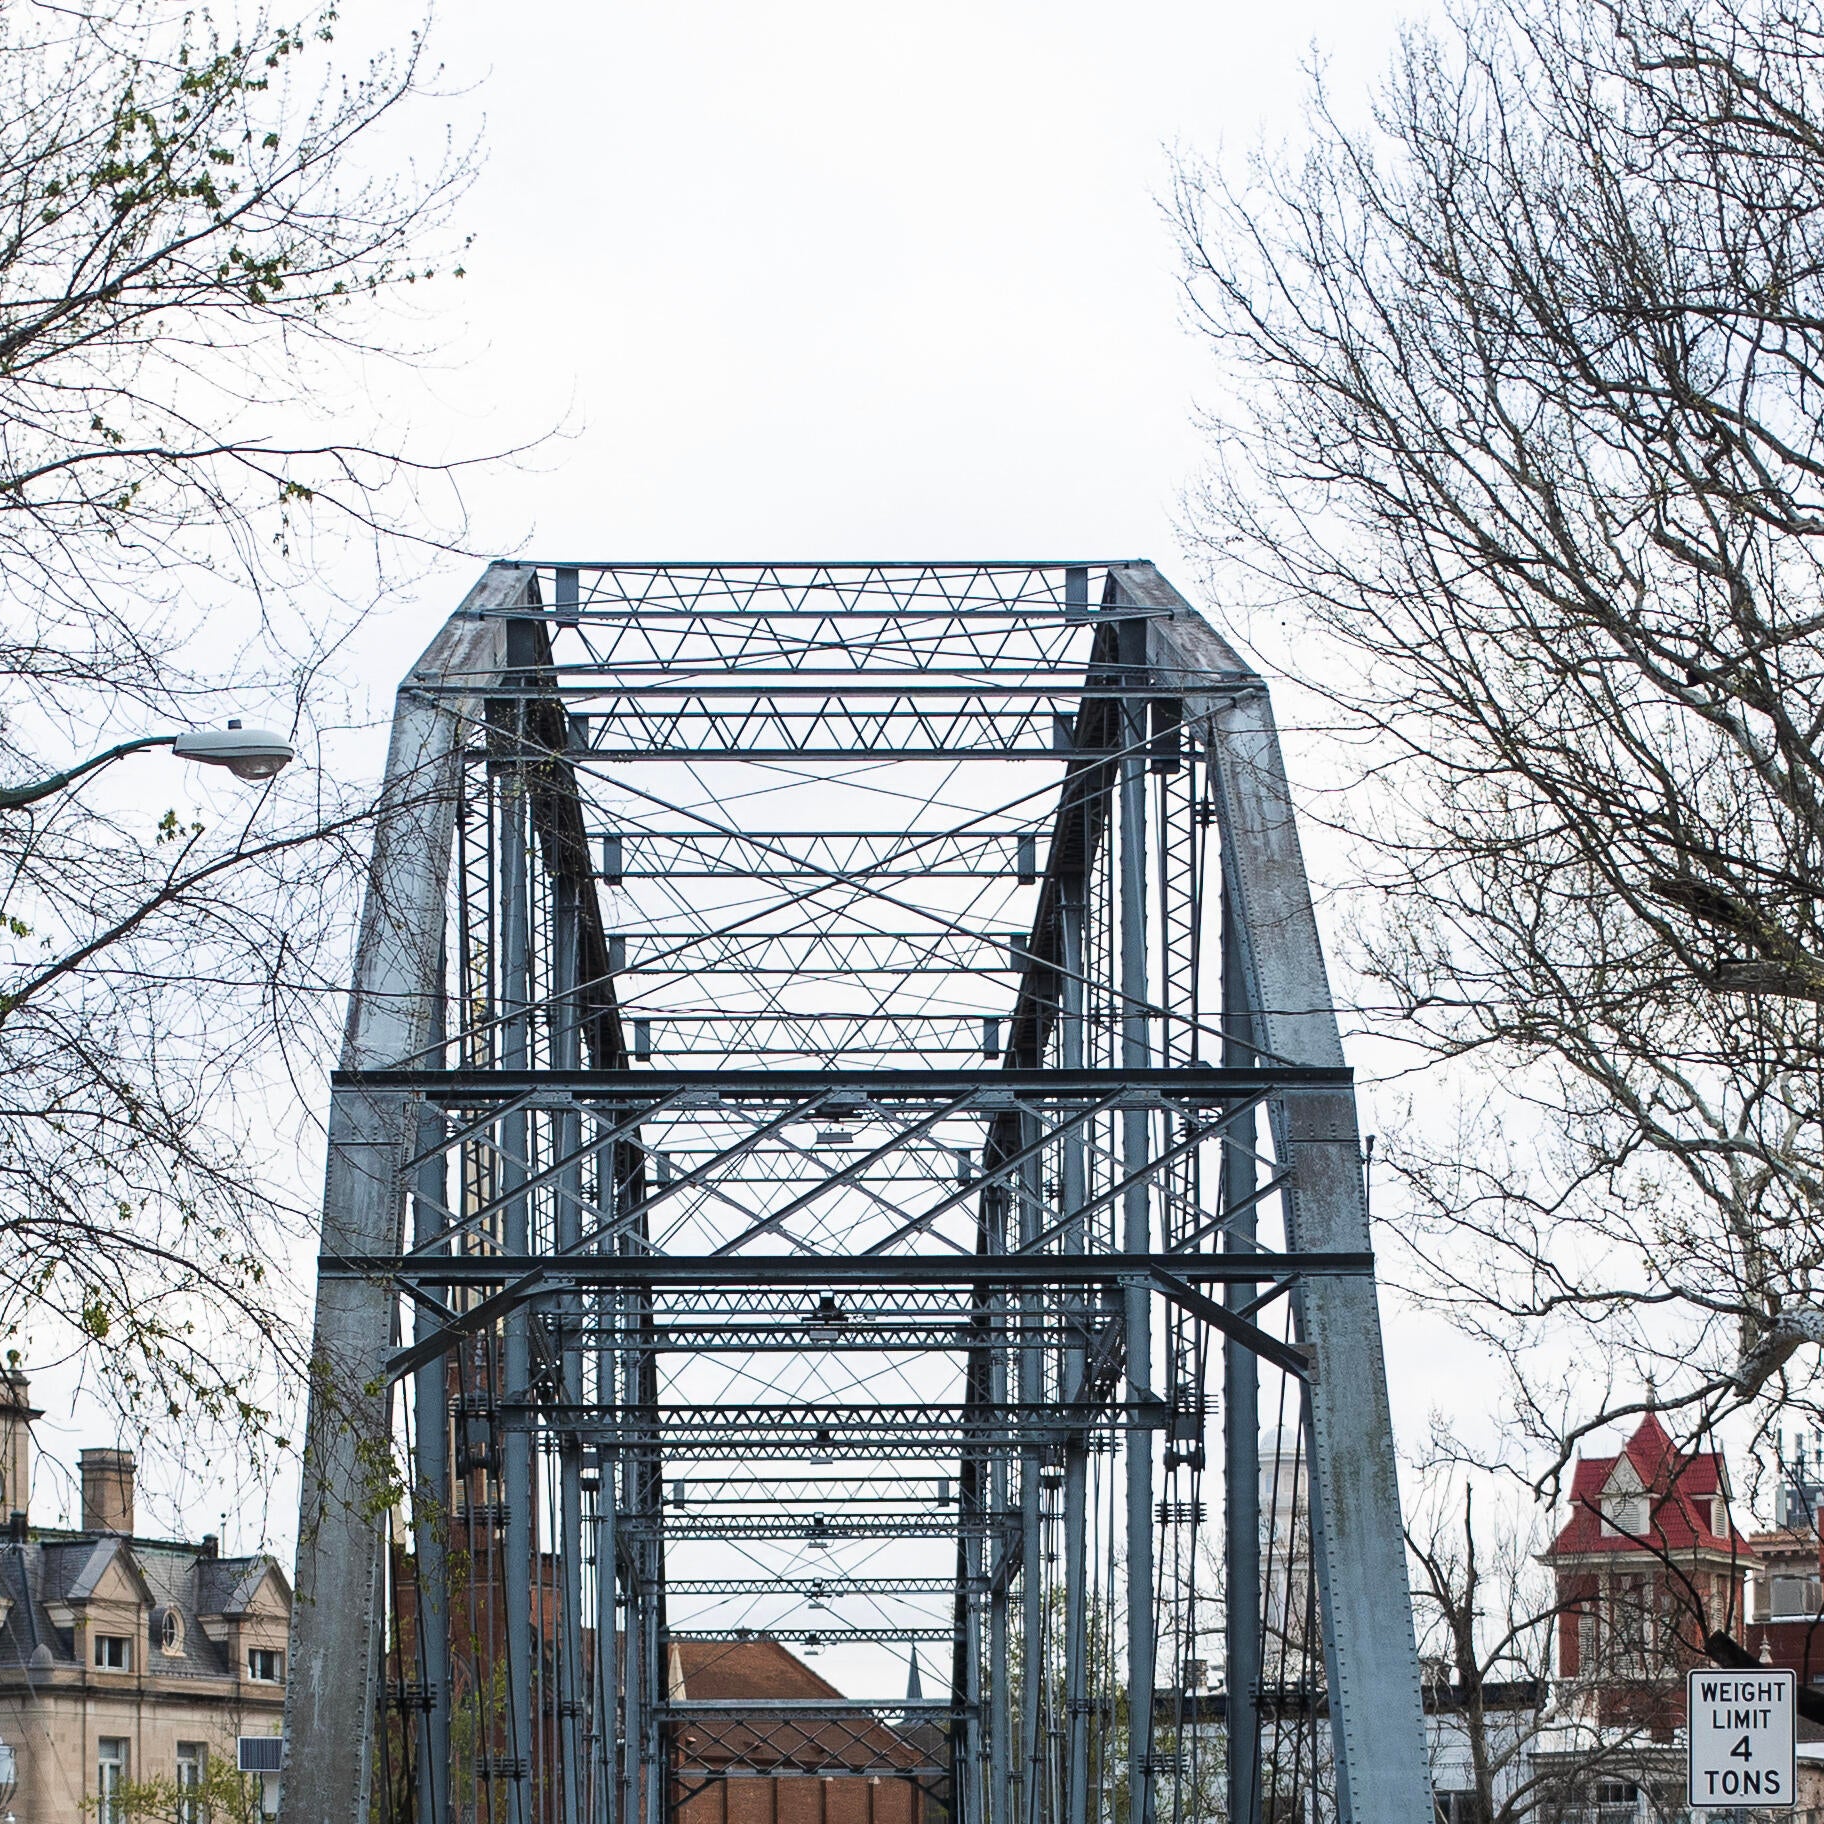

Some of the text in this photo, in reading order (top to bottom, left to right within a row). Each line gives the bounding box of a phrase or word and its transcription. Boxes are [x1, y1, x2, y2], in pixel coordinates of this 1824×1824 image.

[1700, 1681, 1786, 1702] WEIGHT
[1712, 1709, 1771, 1729] LIMIT
[1730, 1735, 1753, 1762] 4
[1704, 1769, 1781, 1795] TONS
